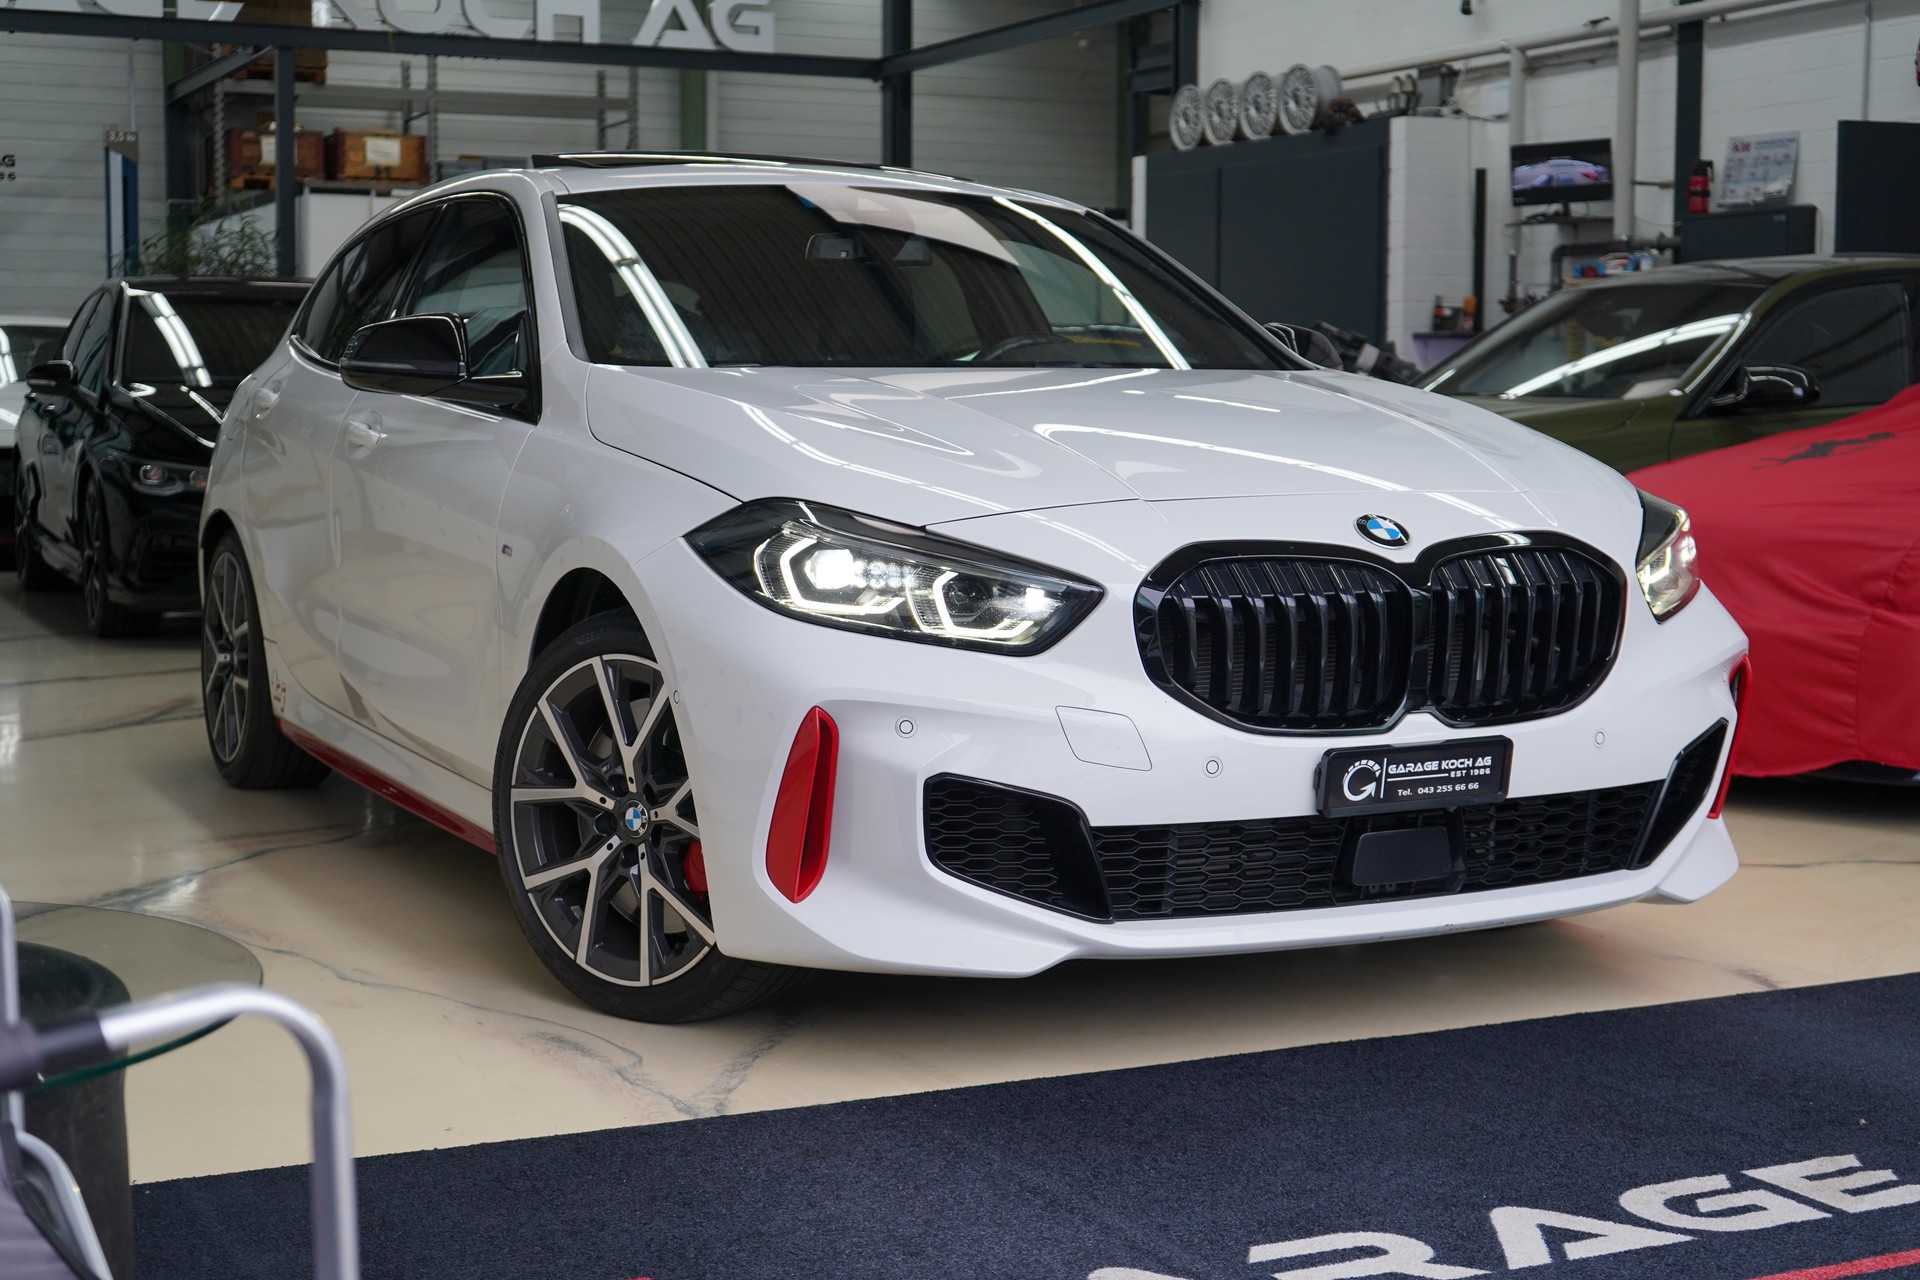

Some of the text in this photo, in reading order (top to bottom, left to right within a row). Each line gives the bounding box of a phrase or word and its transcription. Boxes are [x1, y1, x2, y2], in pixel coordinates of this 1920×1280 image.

[633, 0, 775, 54] AG
[1388, 756, 1492, 774] GARAGE KOCH AG
[1450, 767, 1491, 778] EST 1986
[1397, 782, 1480, 797] Tel. 043 255 66 66
